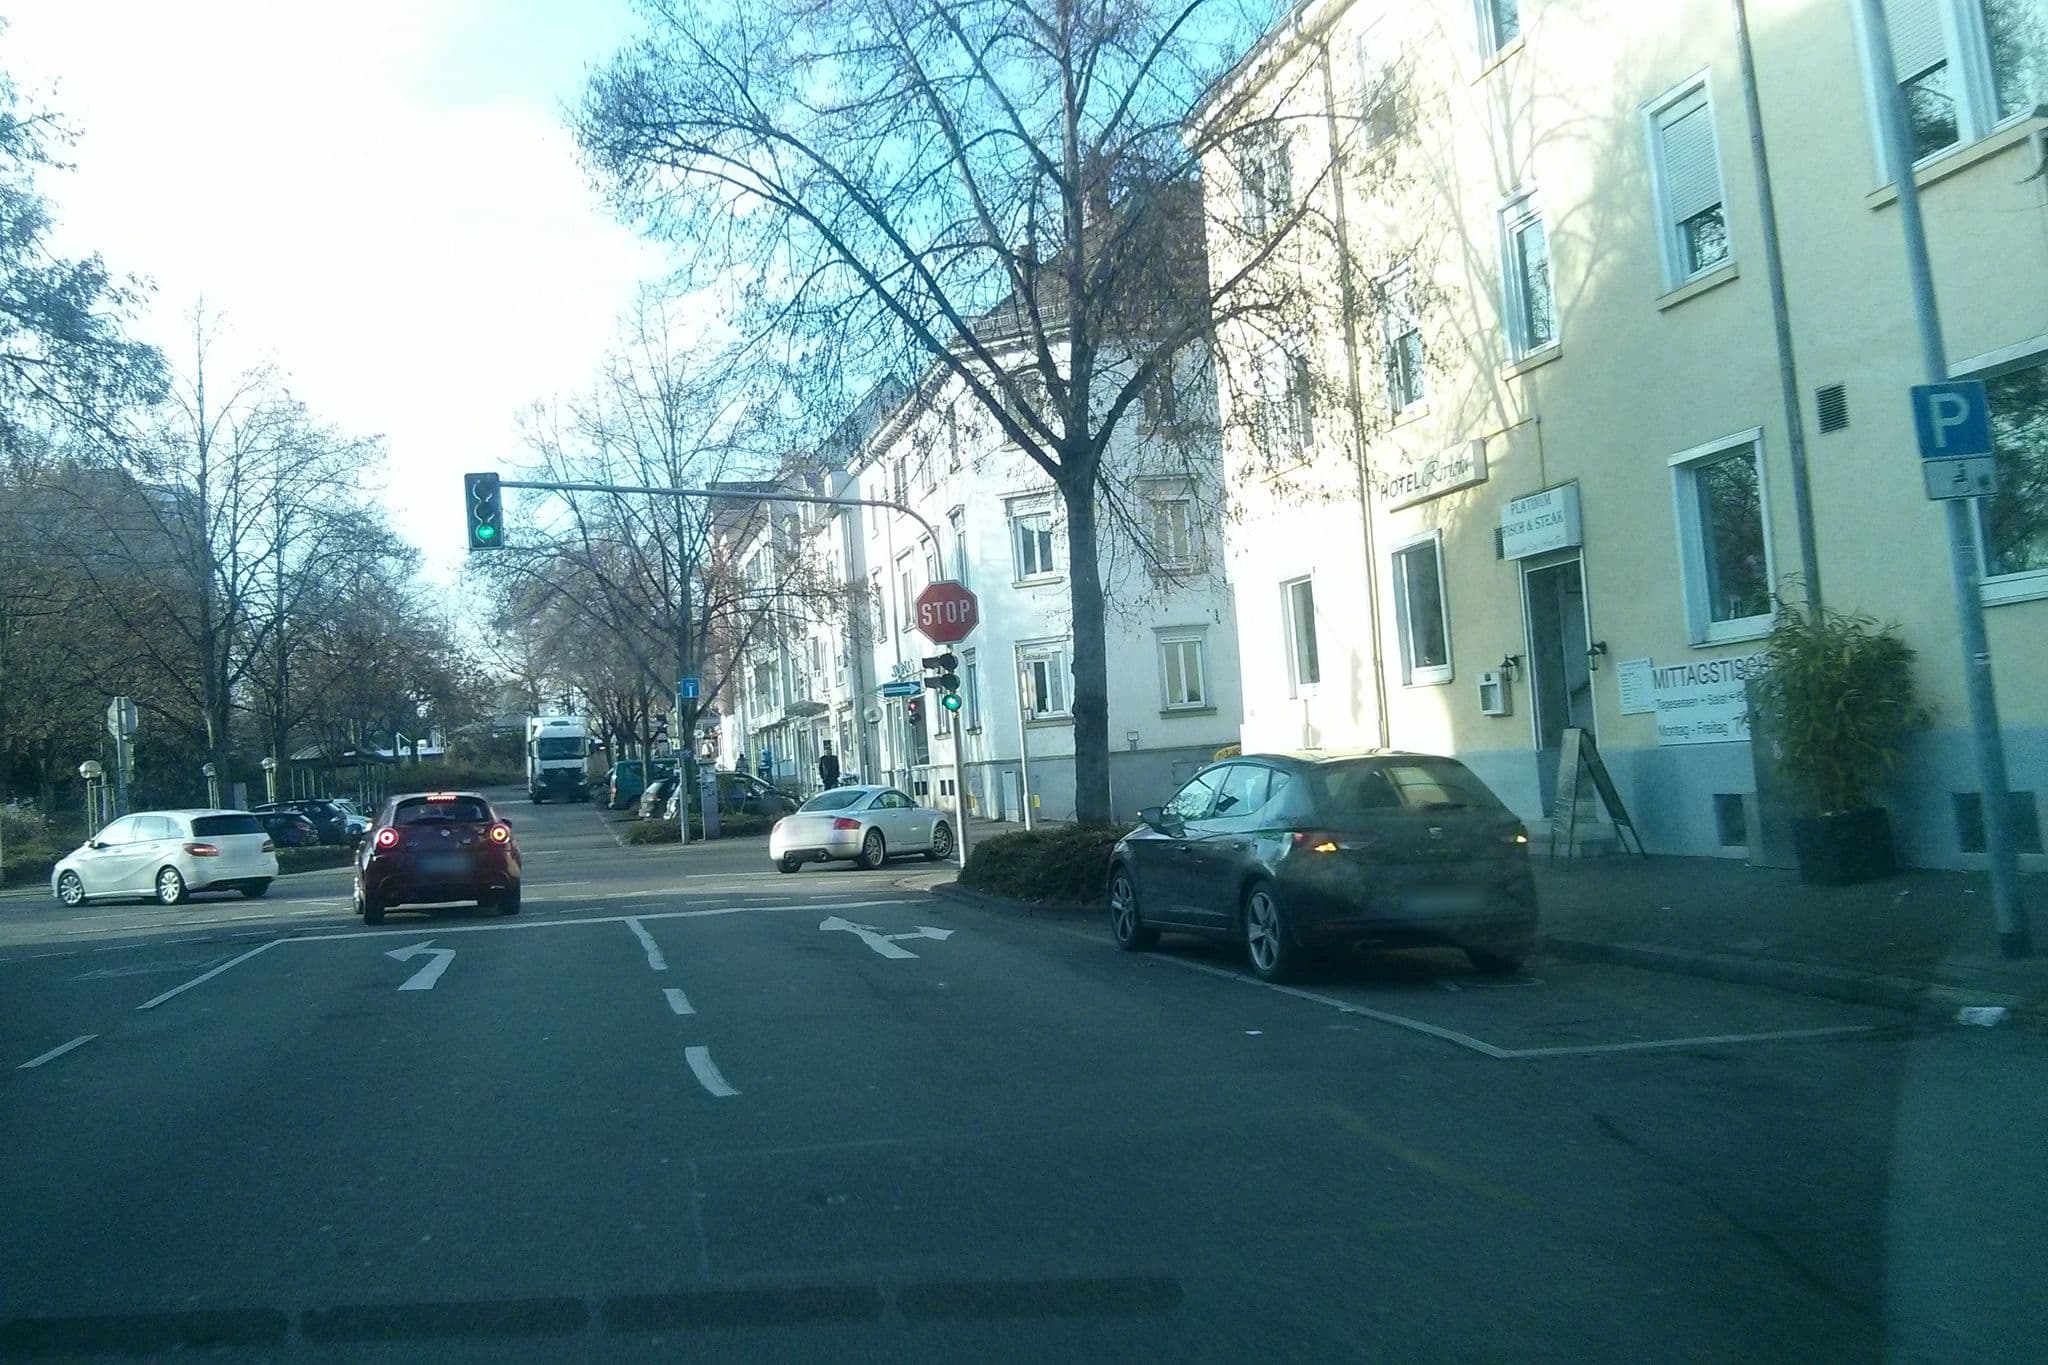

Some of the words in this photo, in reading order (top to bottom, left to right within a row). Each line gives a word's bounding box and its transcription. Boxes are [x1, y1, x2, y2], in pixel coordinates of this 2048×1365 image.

[1929, 392, 1971, 448] P
[1380, 471, 1420, 503] HOTEL
[1511, 493, 1552, 516] PLATINUM
[1535, 510, 1564, 530] STEAK
[921, 599, 970, 627] STOP
[1658, 724, 1690, 740] Montag
[1697, 720, 1728, 737] Freitag
